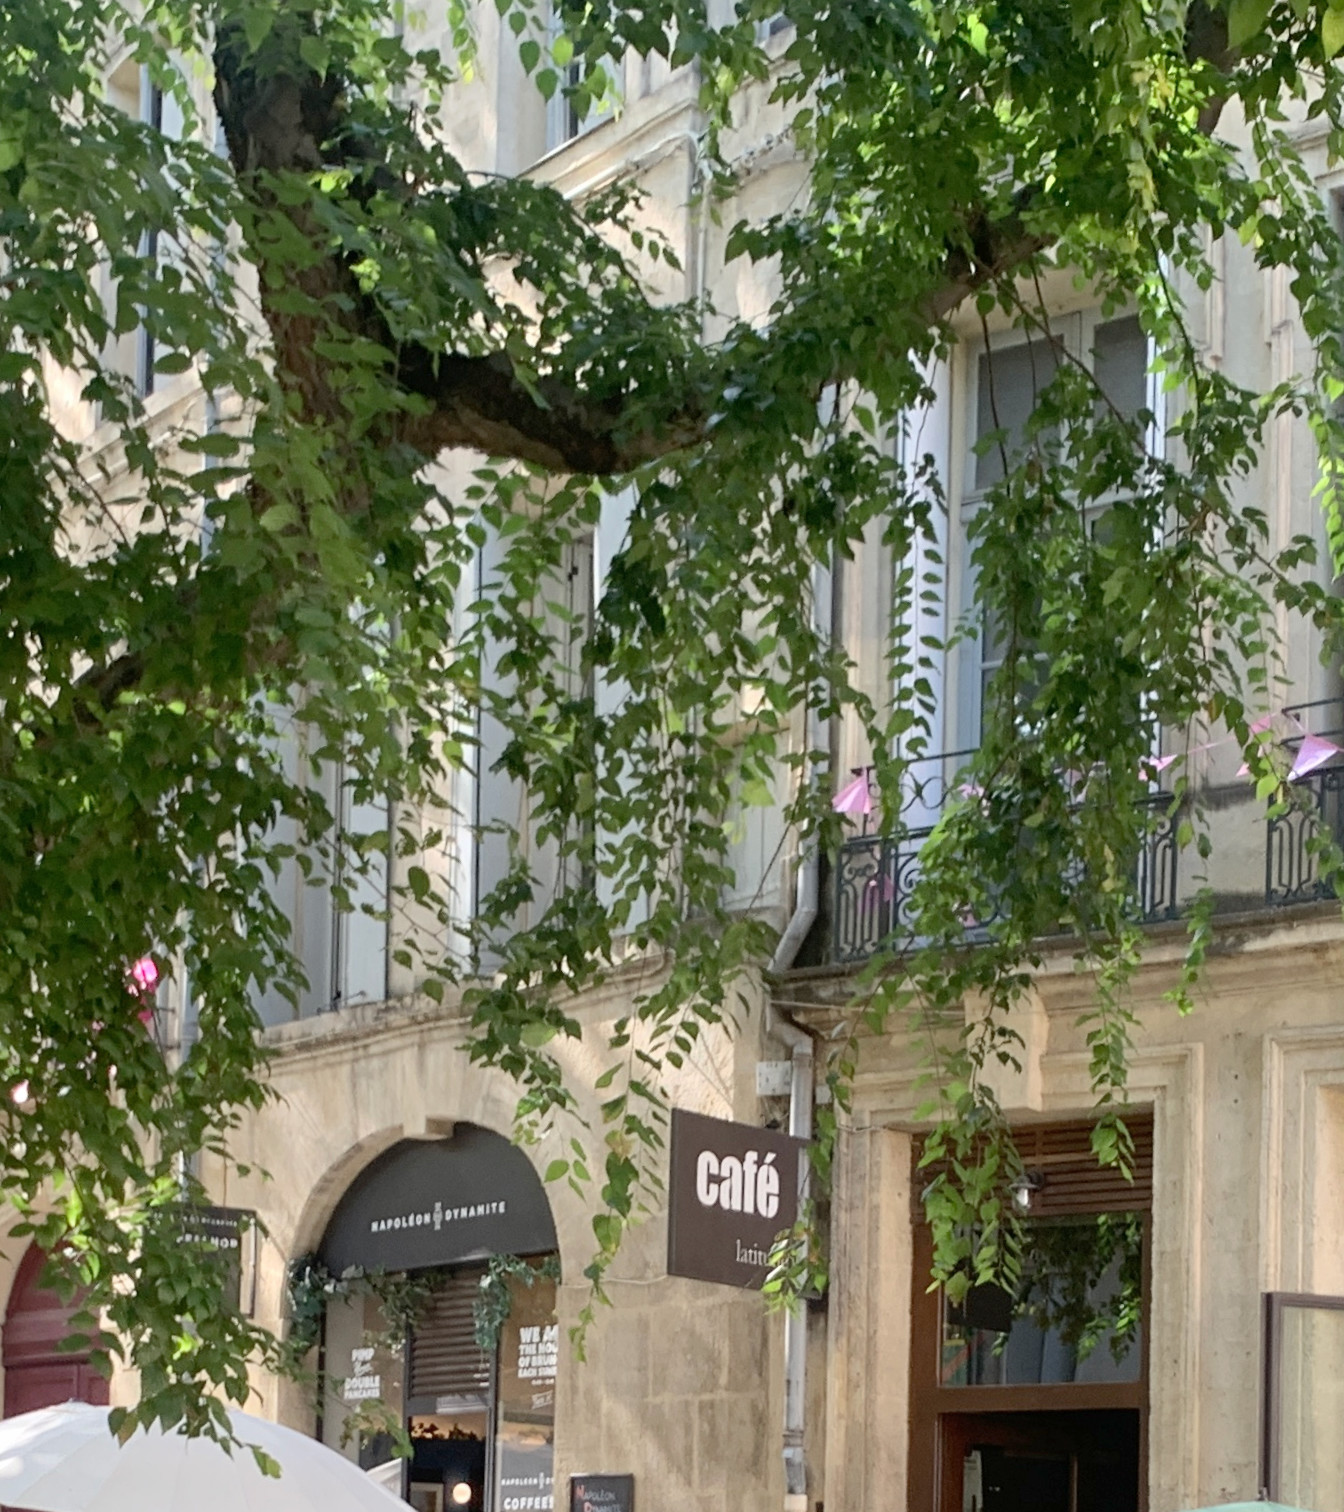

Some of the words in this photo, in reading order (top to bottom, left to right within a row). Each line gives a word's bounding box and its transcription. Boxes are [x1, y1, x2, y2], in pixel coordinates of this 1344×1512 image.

[696, 1150, 780, 1219] café
[370, 1212, 431, 1233] NAPOLÉON
[444, 1200, 506, 1222] DYNAMITE
